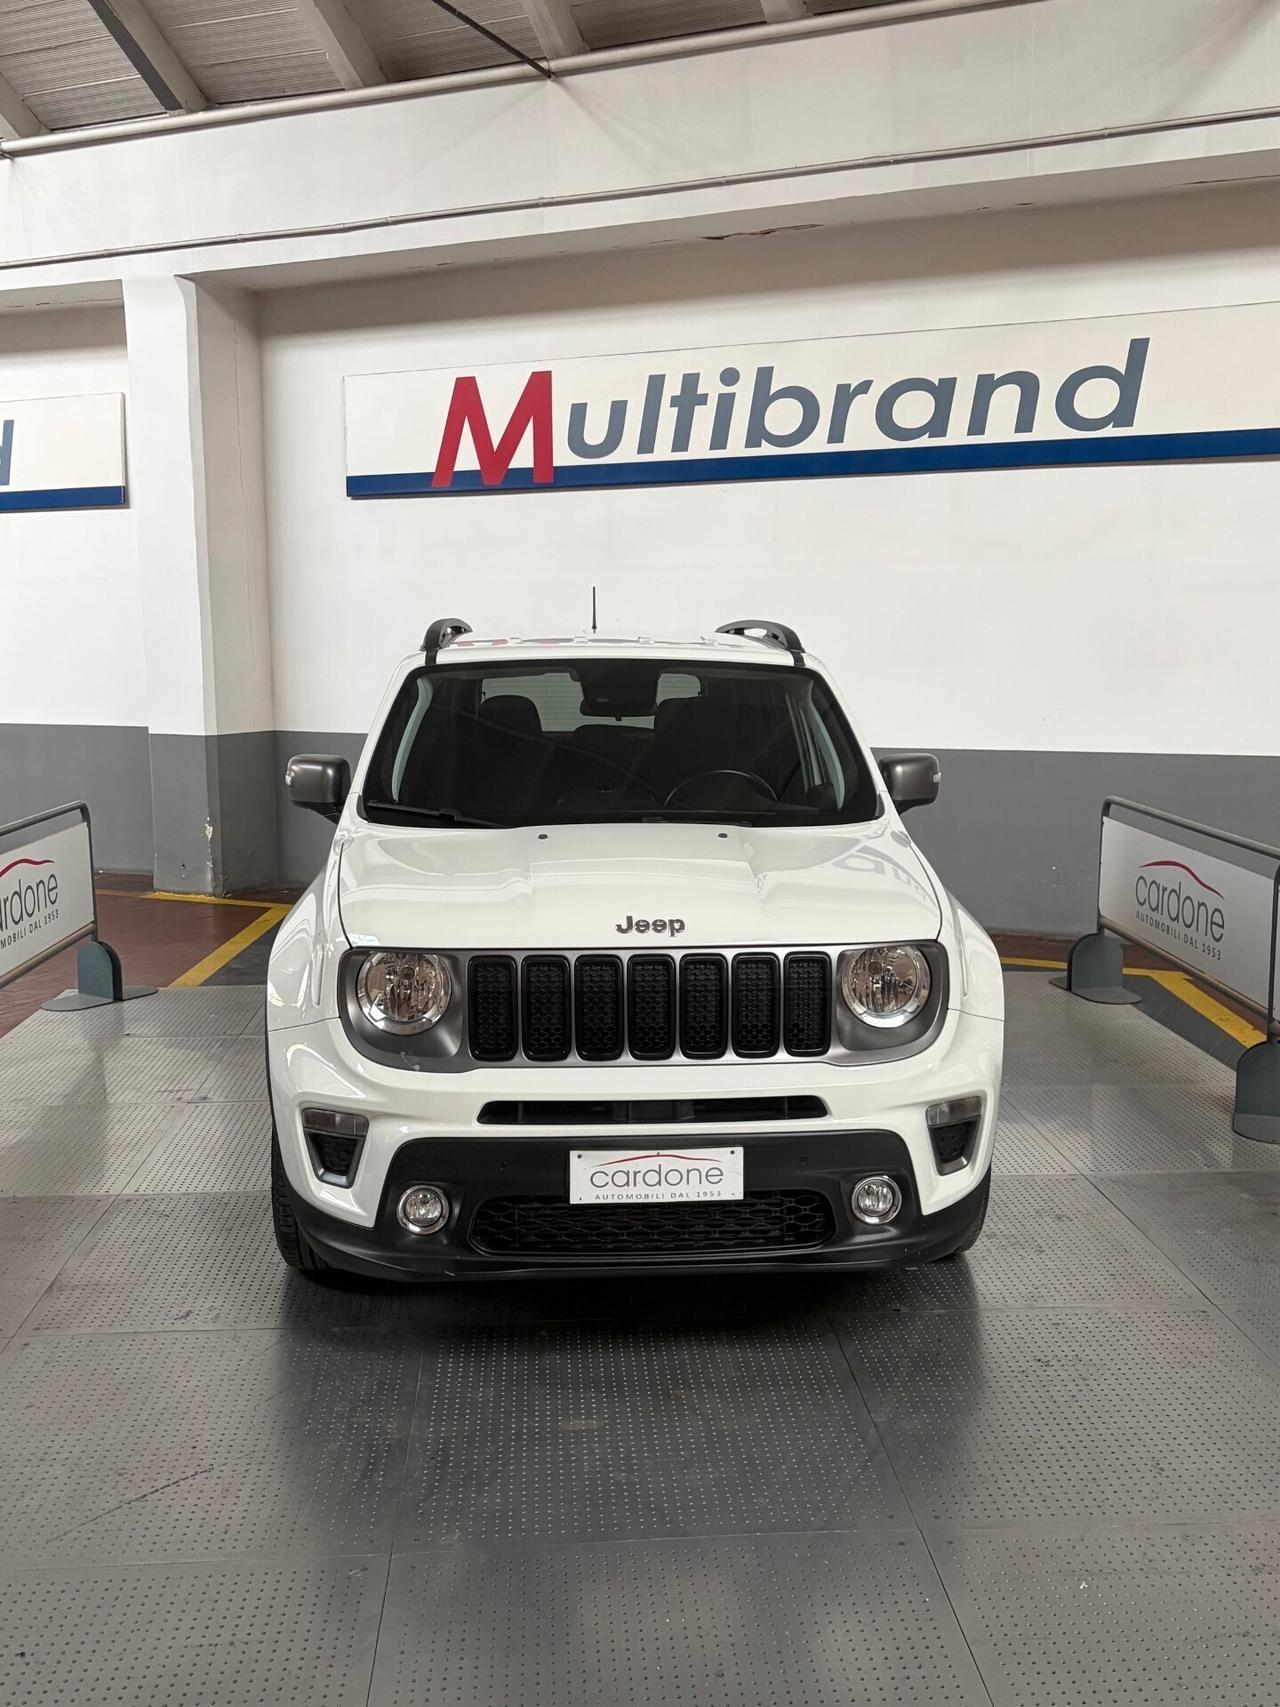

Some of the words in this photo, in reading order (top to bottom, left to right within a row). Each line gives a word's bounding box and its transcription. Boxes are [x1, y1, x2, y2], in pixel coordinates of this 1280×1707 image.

[431, 337, 1150, 488] Multibrand
[0, 873, 58, 932] rdone
[29, 920, 42, 934] DAL
[44, 908, 59, 925] 1953
[1135, 875, 1225, 943] cardone
[615, 915, 686, 937] Jeep
[1135, 910, 1181, 941] AUTOMOBILI
[1183, 933, 1199, 950] DAL
[1201, 943, 1222, 961] 1953
[589, 1163, 724, 1189] cardone
[594, 1193, 665, 1201] AUTOMOBILI
[696, 1190, 722, 1198] 1953
